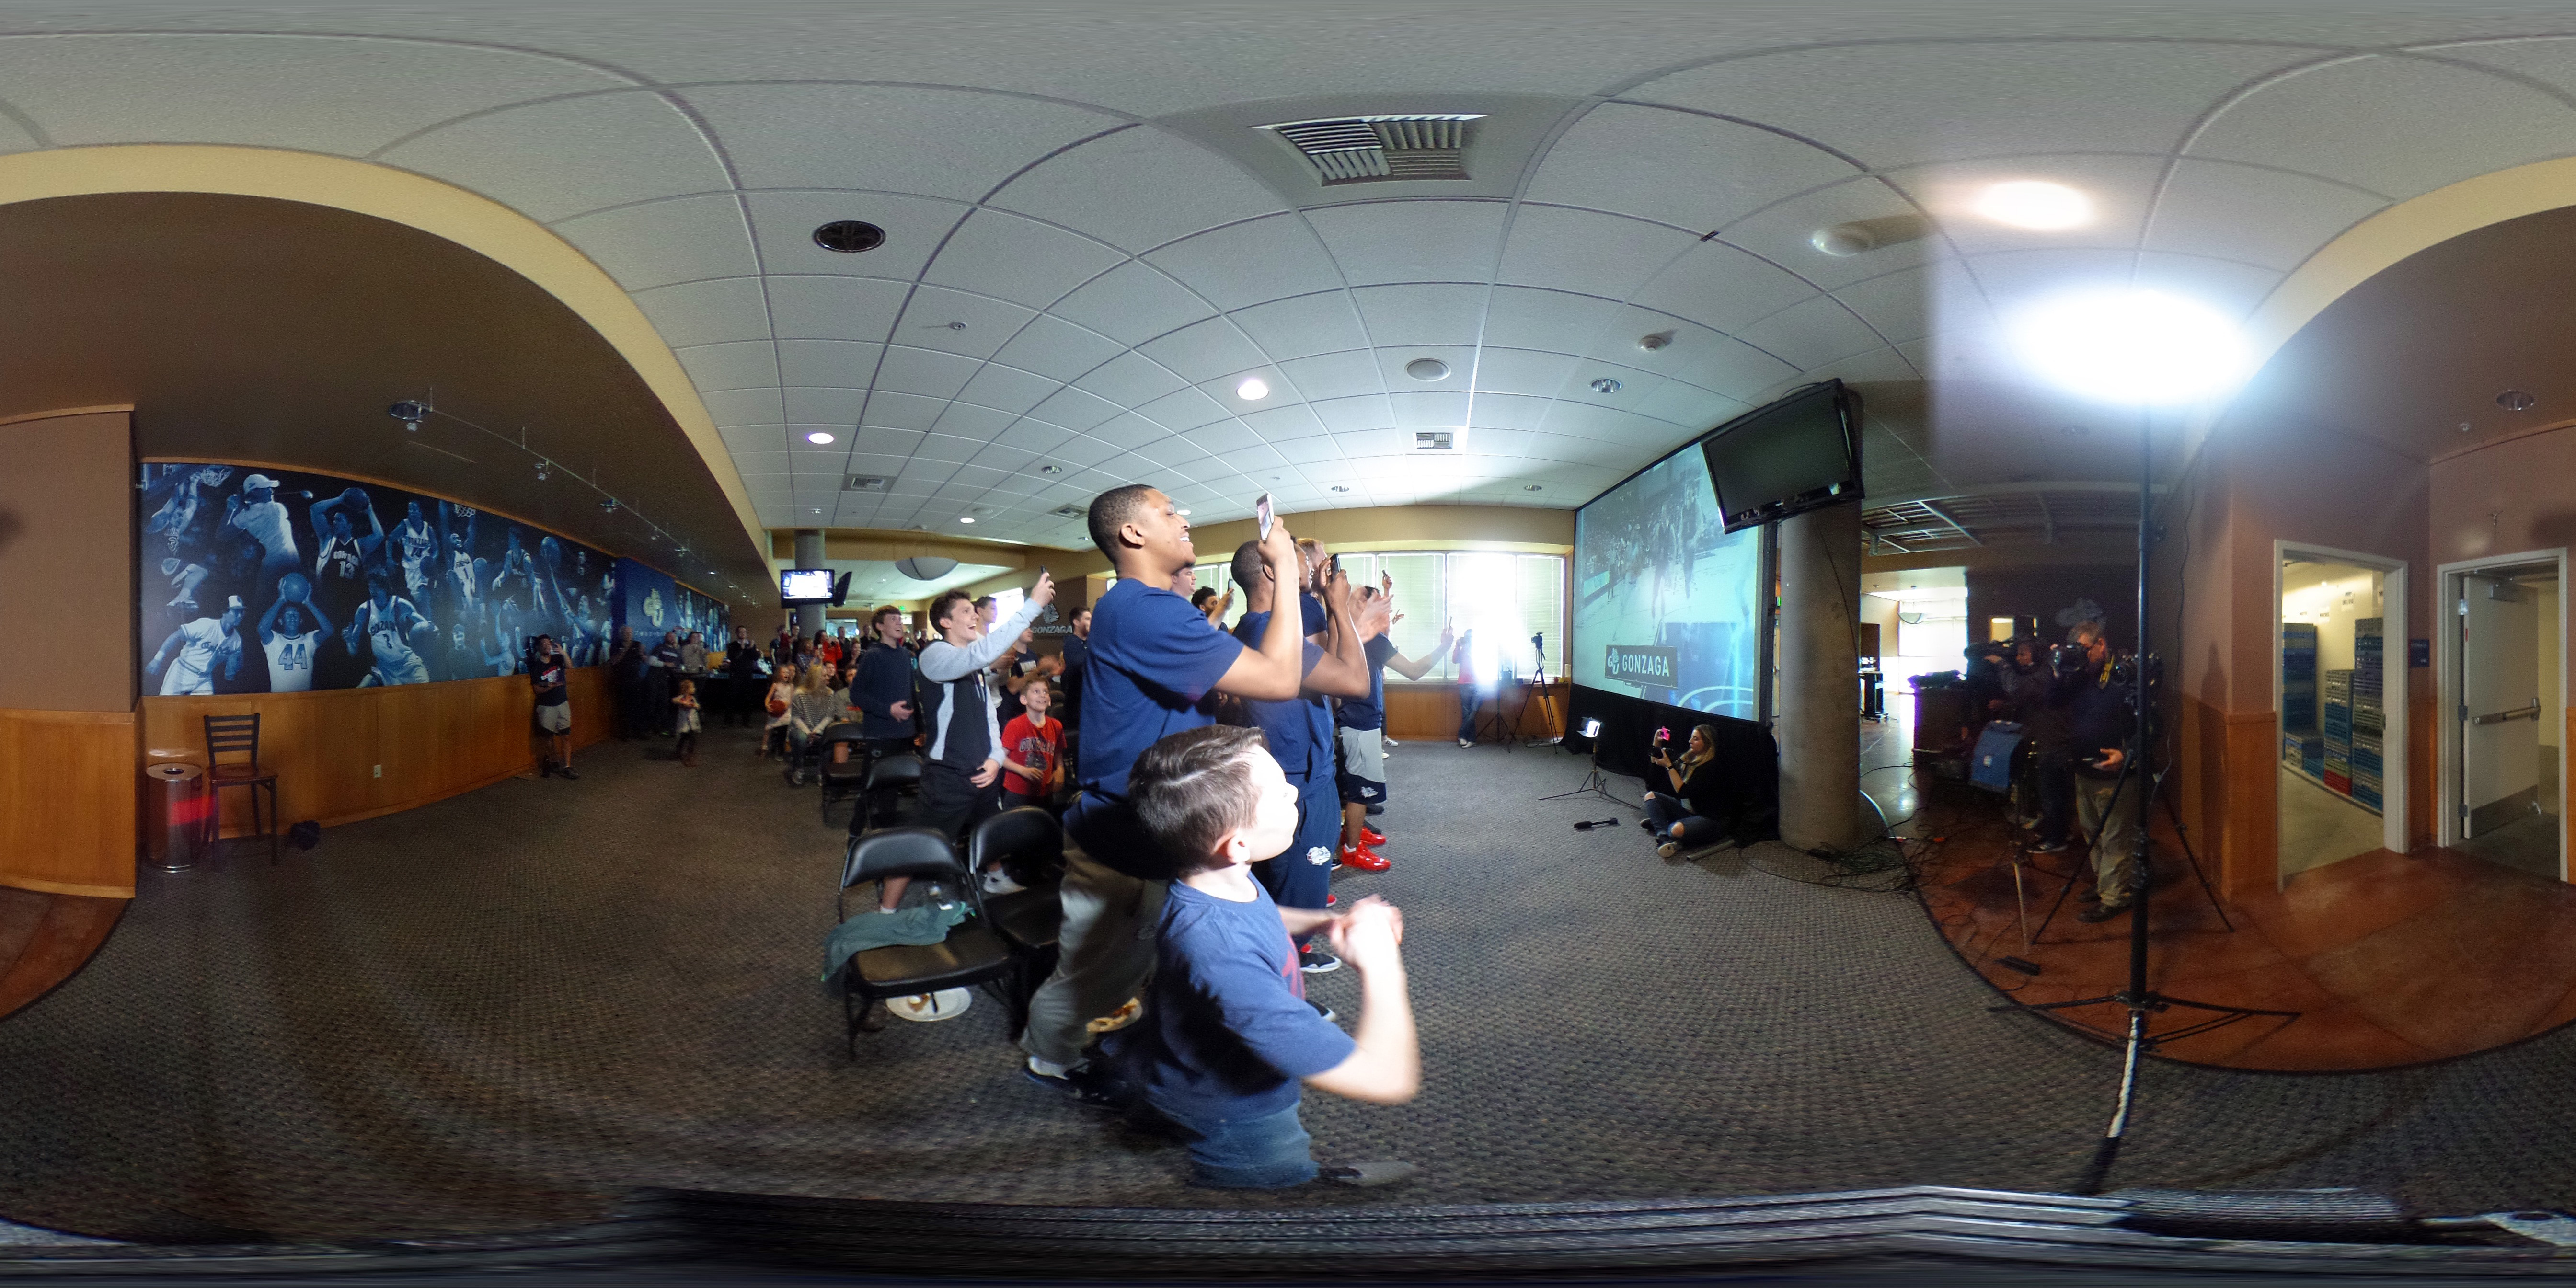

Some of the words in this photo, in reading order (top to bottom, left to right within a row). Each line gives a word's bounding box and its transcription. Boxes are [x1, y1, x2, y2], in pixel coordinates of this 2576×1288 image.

[1032, 625, 1073, 634] GONZAGA
[278, 643, 307, 670] 44
[1622, 654, 1669, 677] GONZAGA
